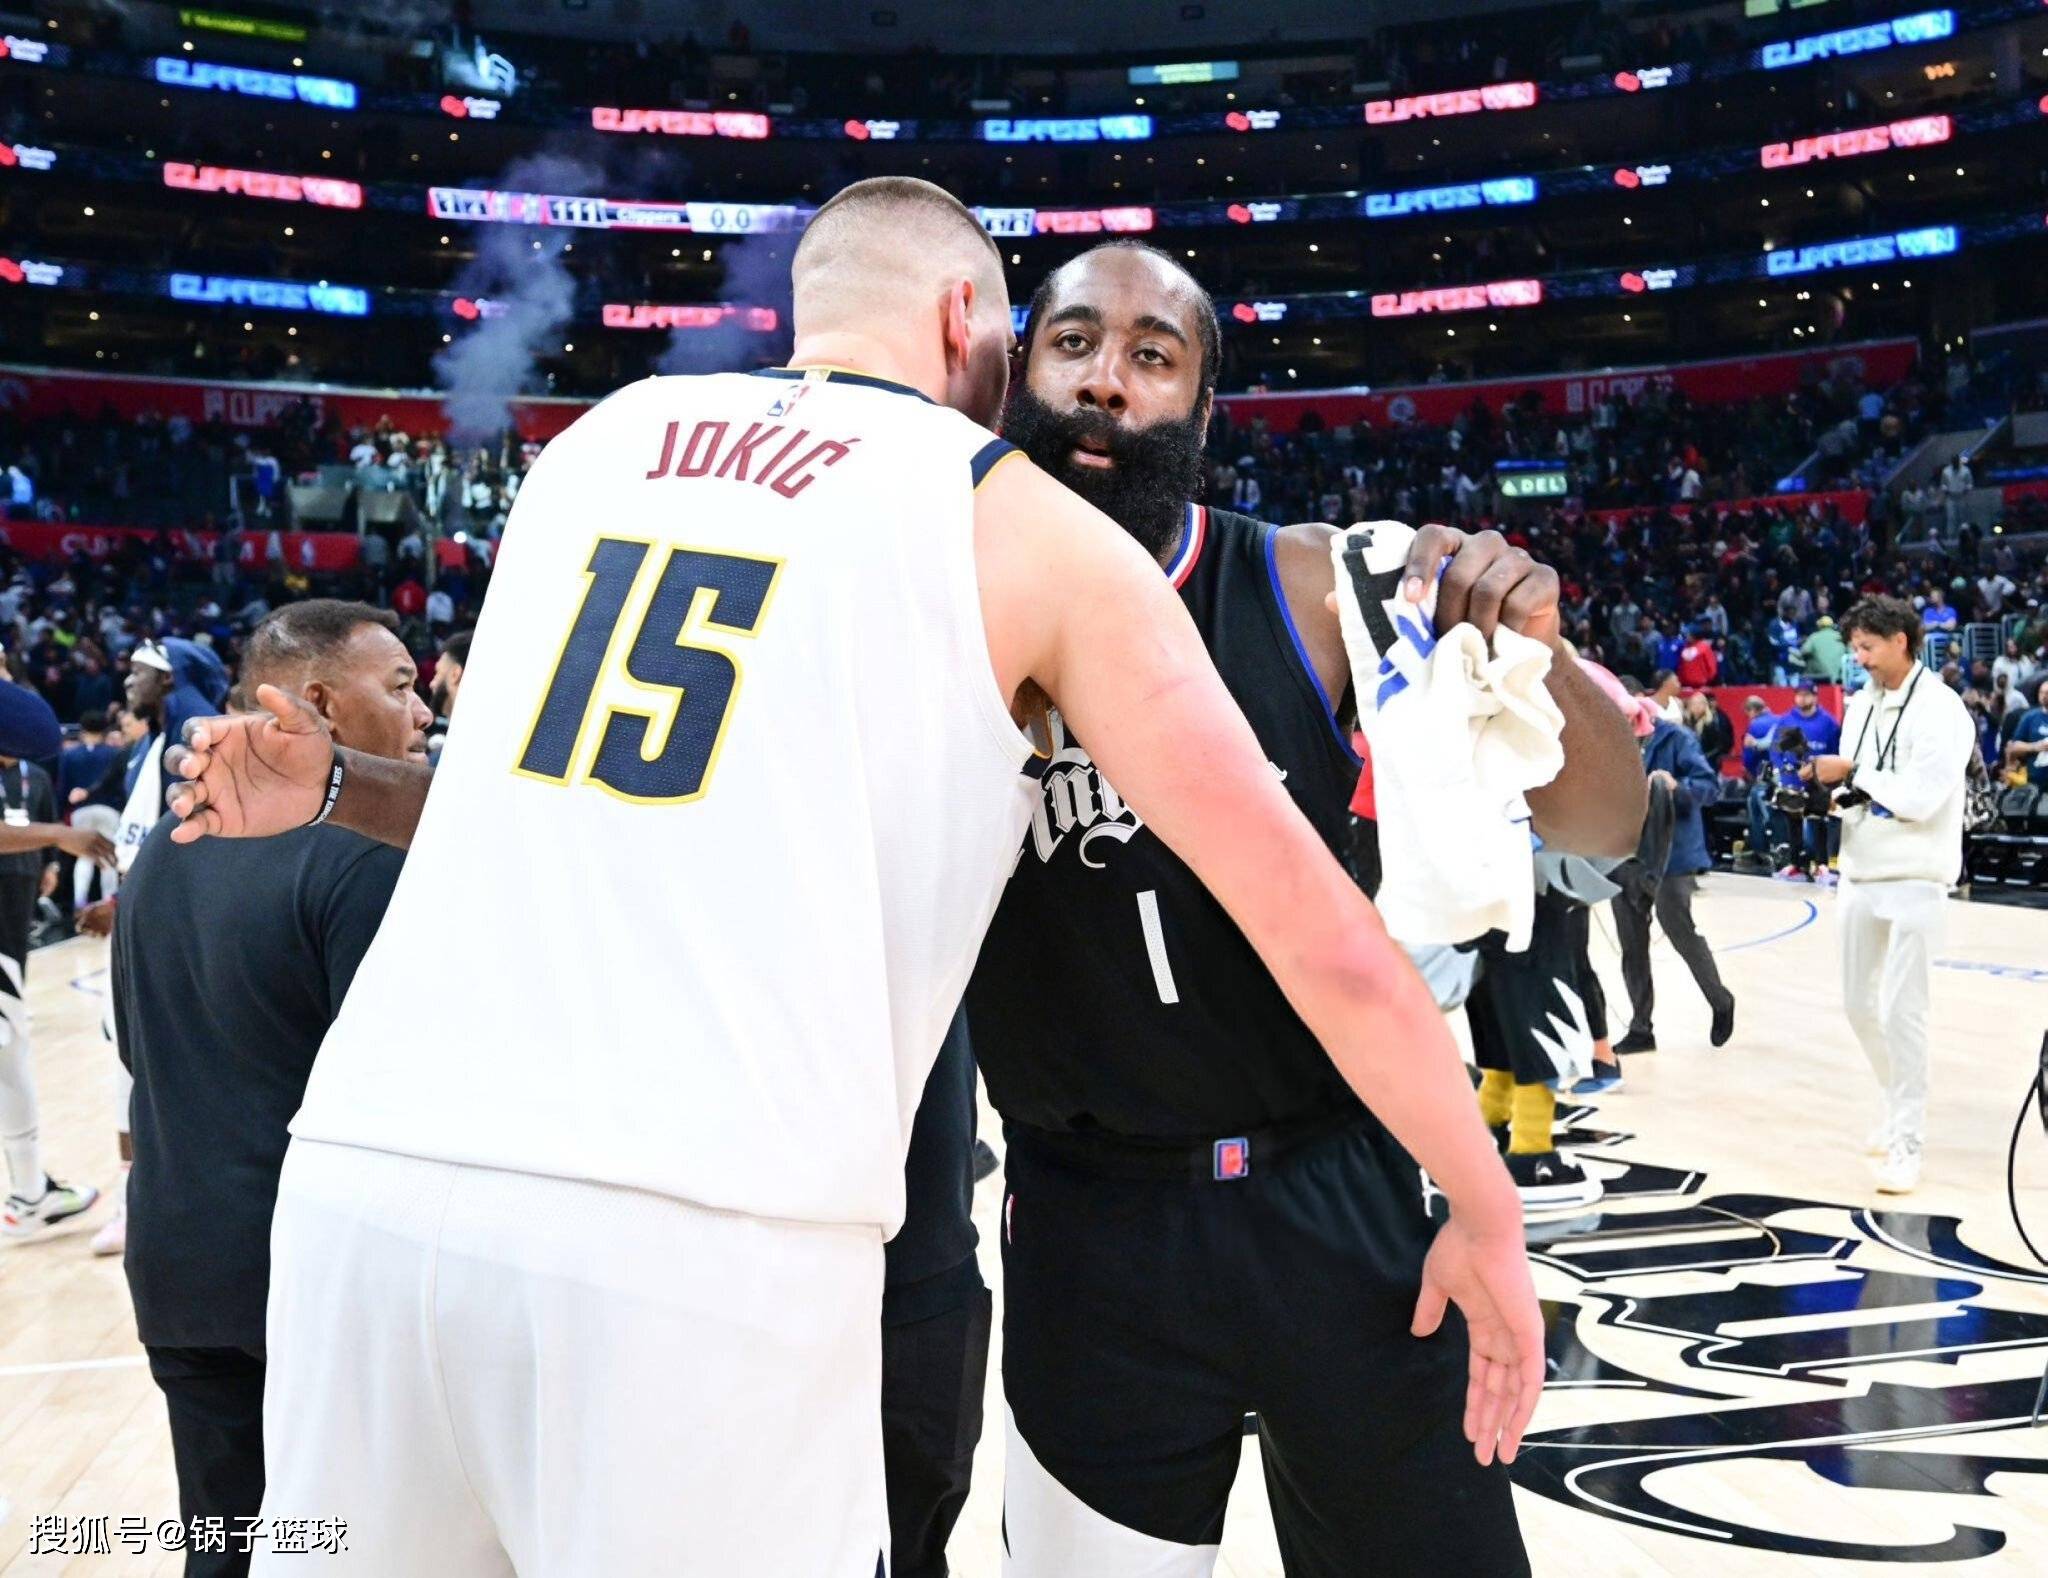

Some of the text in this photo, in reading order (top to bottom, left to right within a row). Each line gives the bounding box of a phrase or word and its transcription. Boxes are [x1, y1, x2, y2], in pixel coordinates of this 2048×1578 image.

[1763, 10, 1954, 68] CLIPPERS WIN
[1762, 116, 1949, 167] CLIPPERS WIN
[1765, 227, 1959, 275] CLIPPERS WIN
[646, 420, 861, 499] JOKIĆ
[510, 533, 787, 805] 15
[1136, 889, 1180, 1004] 1
